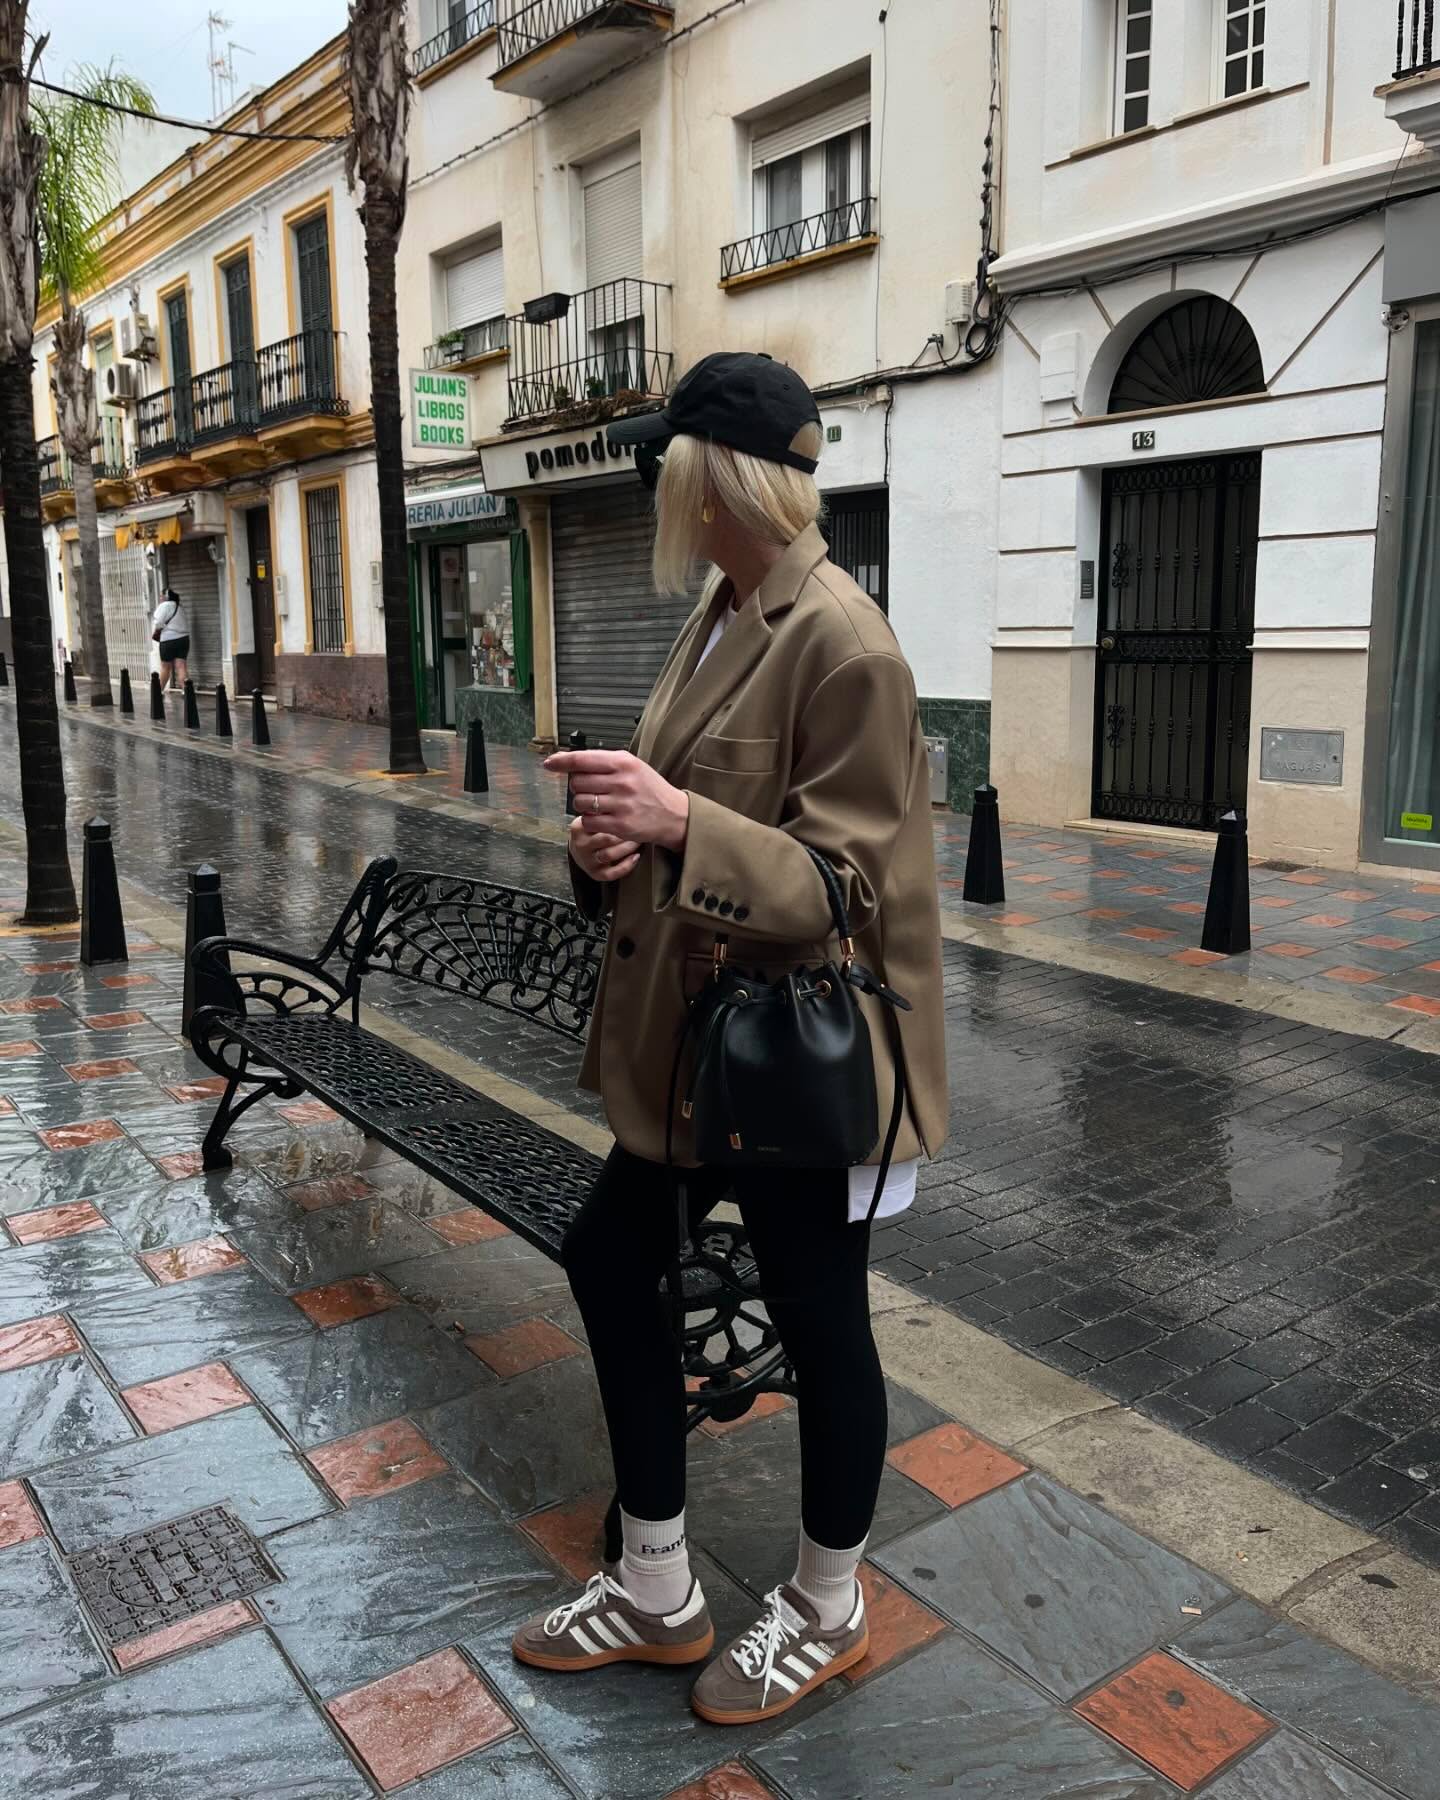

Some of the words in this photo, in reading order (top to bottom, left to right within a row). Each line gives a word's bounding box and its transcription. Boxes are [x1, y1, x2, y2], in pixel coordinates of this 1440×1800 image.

[415, 376, 467, 397] JULIAN'S
[418, 400, 465, 420] LIBROS
[420, 424, 465, 444] BOOKS
[1134, 432, 1153, 447] 13
[448, 495, 497, 519] JULIAN
